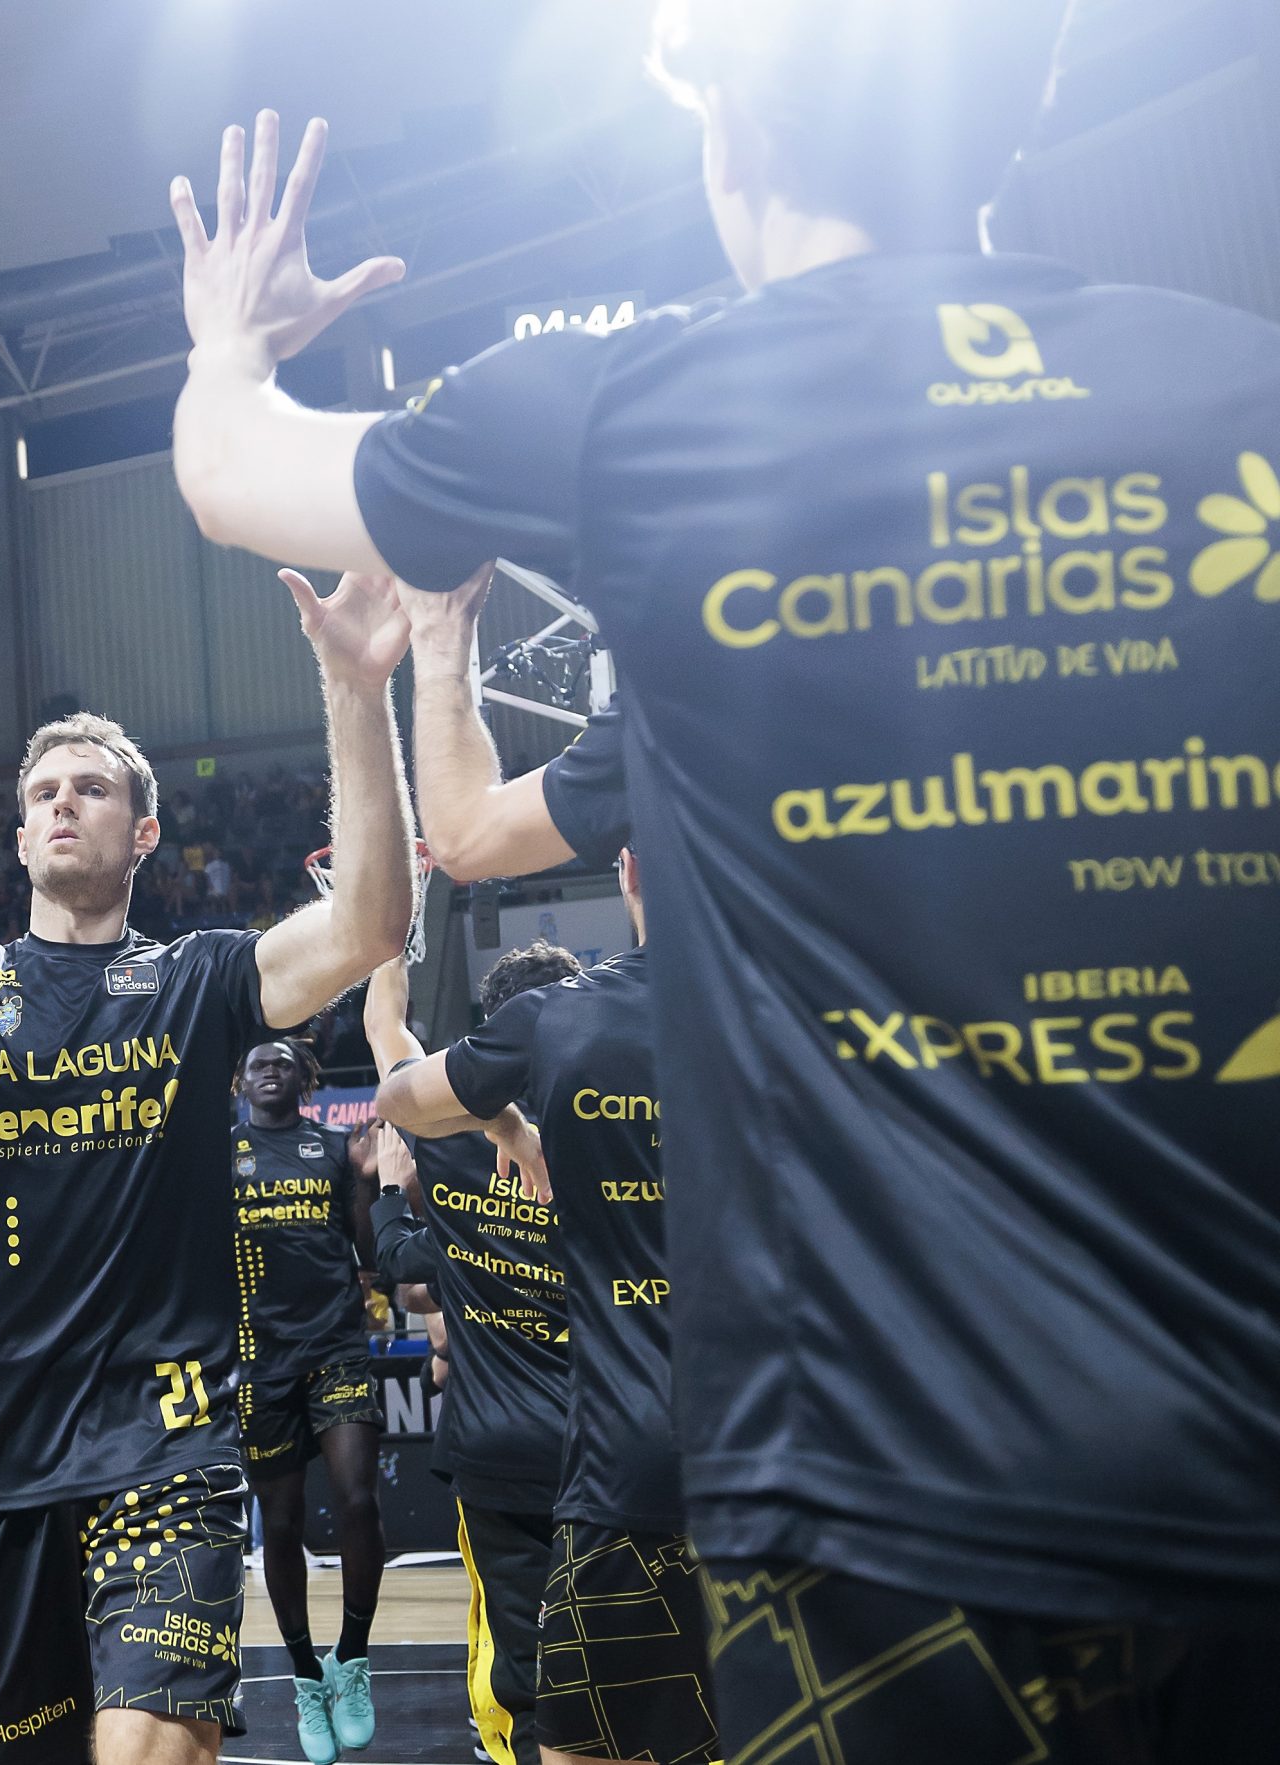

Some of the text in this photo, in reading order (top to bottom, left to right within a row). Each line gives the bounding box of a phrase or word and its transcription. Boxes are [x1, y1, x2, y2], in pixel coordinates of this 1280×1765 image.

[927, 465, 1169, 549] Islas
[702, 538, 1174, 650] Canarias
[1057, 642, 1098, 678] DE
[1104, 636, 1179, 674] VIDA
[771, 736, 1280, 843] azulmarin
[1068, 855, 1183, 892] new
[113, 981, 155, 990] endesa
[1024, 965, 1191, 1002] IBERIA
[26, 1033, 181, 1081] LAGUNA
[573, 1088, 662, 1120] Can
[260, 1178, 332, 1197] LAGUNA
[432, 1183, 550, 1226] Canarias
[488, 1172, 540, 1201] Isla
[478, 1222, 547, 1244] LATITUD DE VIDA
[447, 1244, 565, 1285] azulmarin
[612, 1279, 671, 1306] EXP
[155, 1361, 212, 1431] 21
[120, 1623, 209, 1655] Canarias
[164, 1610, 212, 1637] Islas
[154, 1649, 182, 1663] LATITUD
